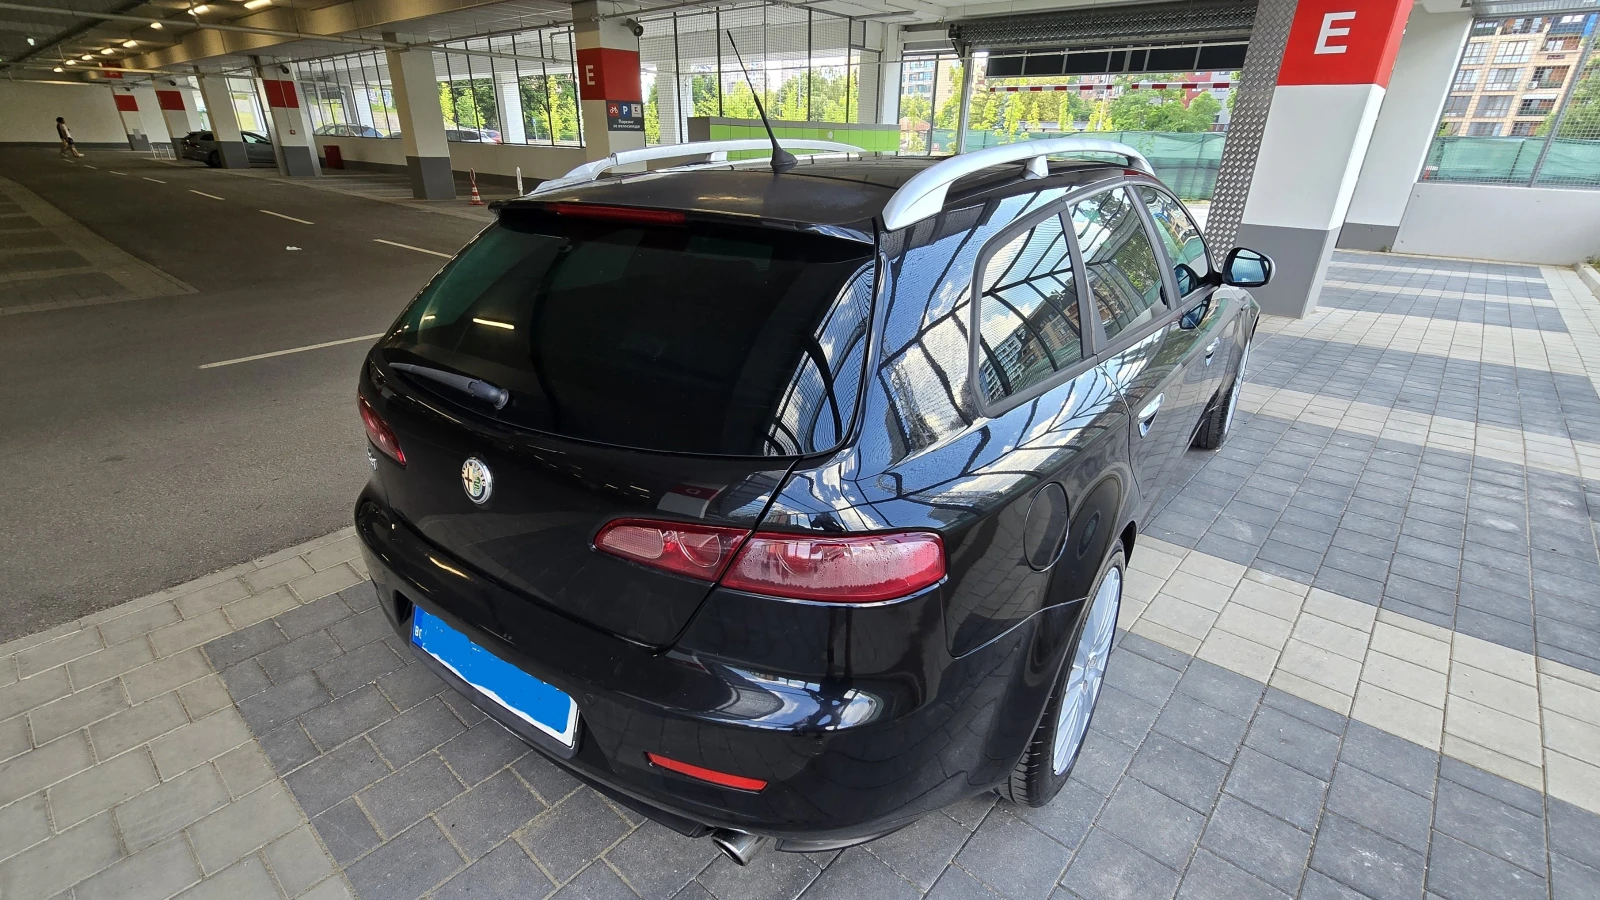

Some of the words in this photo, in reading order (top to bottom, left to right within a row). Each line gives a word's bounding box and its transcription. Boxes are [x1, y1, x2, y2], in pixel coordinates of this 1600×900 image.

[1314, 11, 1356, 54] E
[585, 64, 595, 86] E
[622, 105, 628, 115] P
